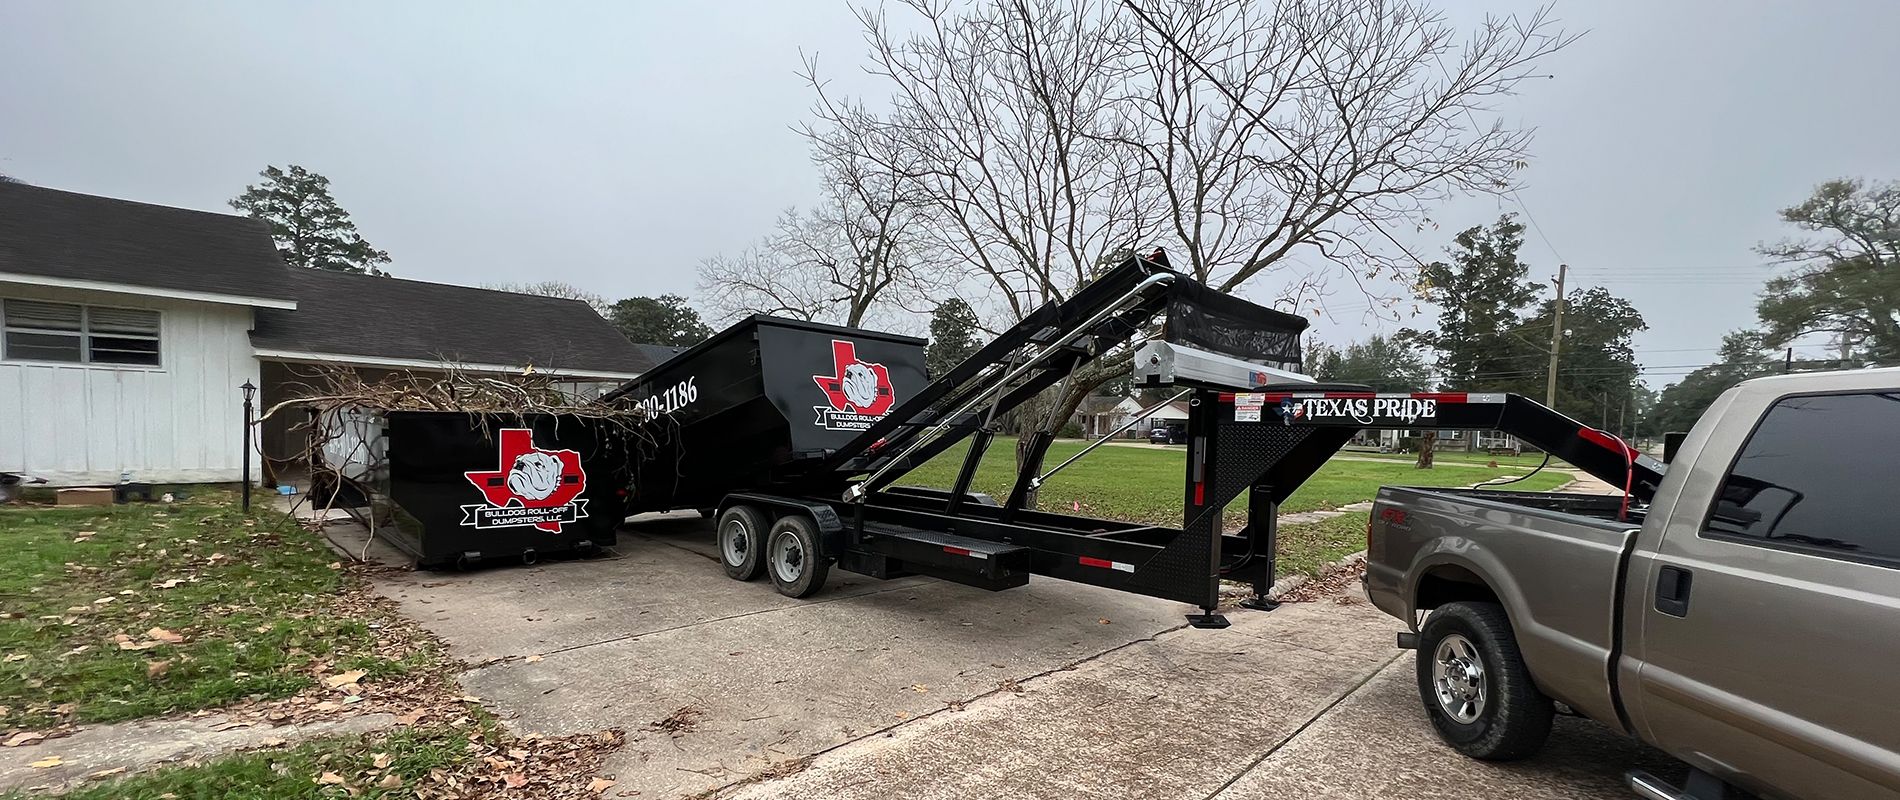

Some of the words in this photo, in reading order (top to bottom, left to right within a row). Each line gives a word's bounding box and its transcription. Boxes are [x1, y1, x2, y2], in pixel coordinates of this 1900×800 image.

[636, 376, 697, 426] 00-1186
[1303, 399, 1373, 424] TEXAS
[1373, 399, 1436, 424] PRIDE
[492, 516, 545, 525] DUMPSTERS,
